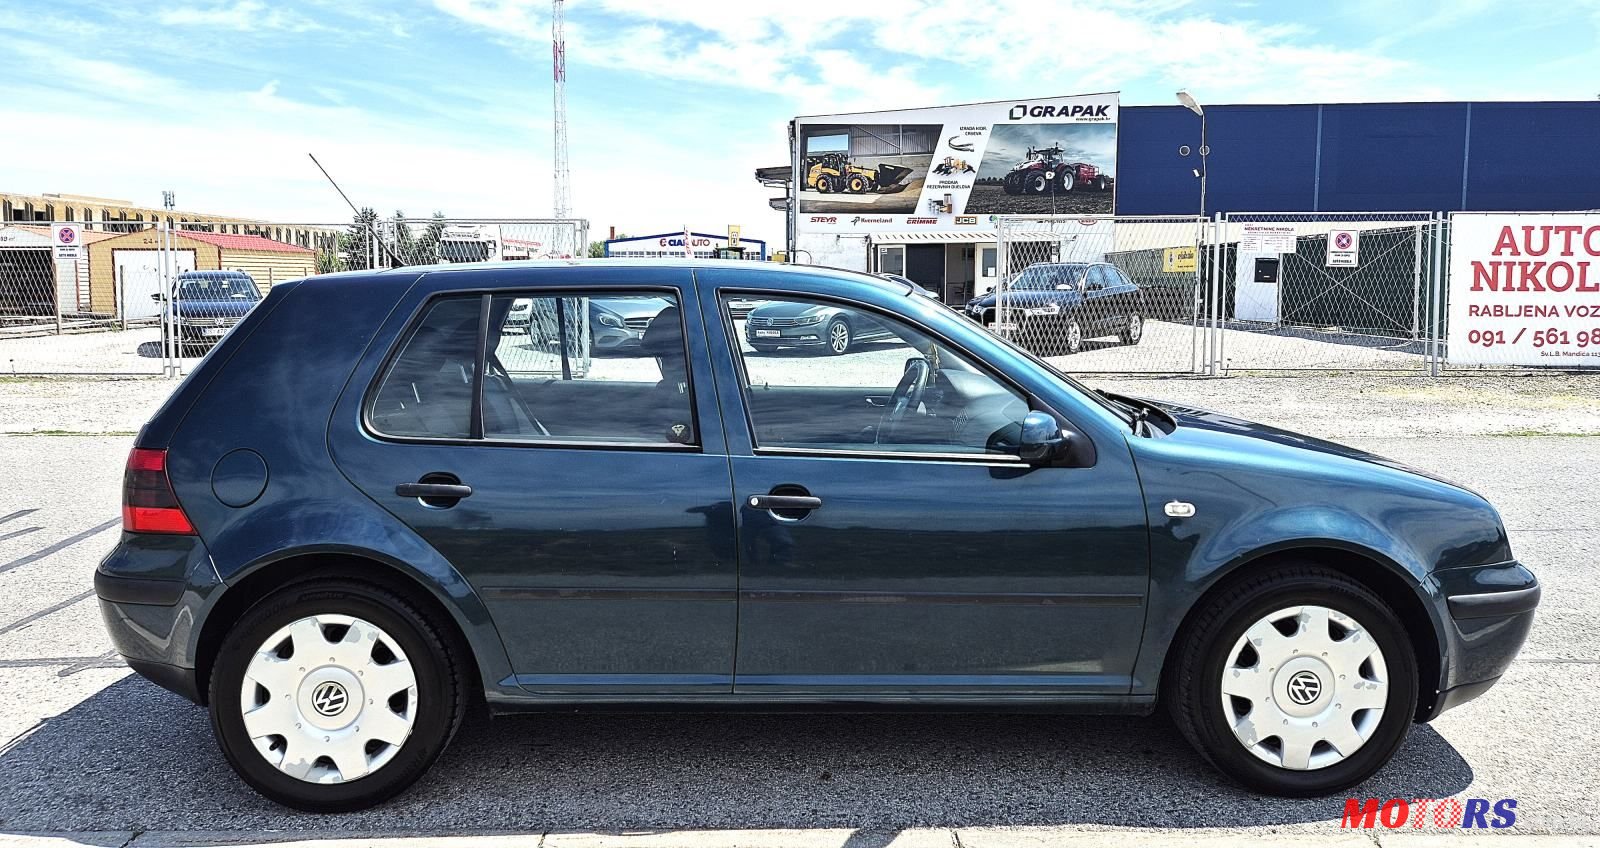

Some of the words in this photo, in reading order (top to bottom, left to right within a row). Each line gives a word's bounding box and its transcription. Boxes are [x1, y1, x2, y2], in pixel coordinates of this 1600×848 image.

[1029, 104, 1111, 117] GRAPAK
[906, 217, 938, 225] GRIMME
[1491, 225, 1600, 256] AUTO
[1470, 261, 1600, 292] NIKOL
[1468, 304, 1560, 317] RABLJENA
[1564, 305, 1600, 318] VOZ
[1468, 329, 1506, 347] 091
[1512, 327, 1527, 344] /
[1533, 328, 1570, 348] 561
[1576, 328, 1600, 348] 98
